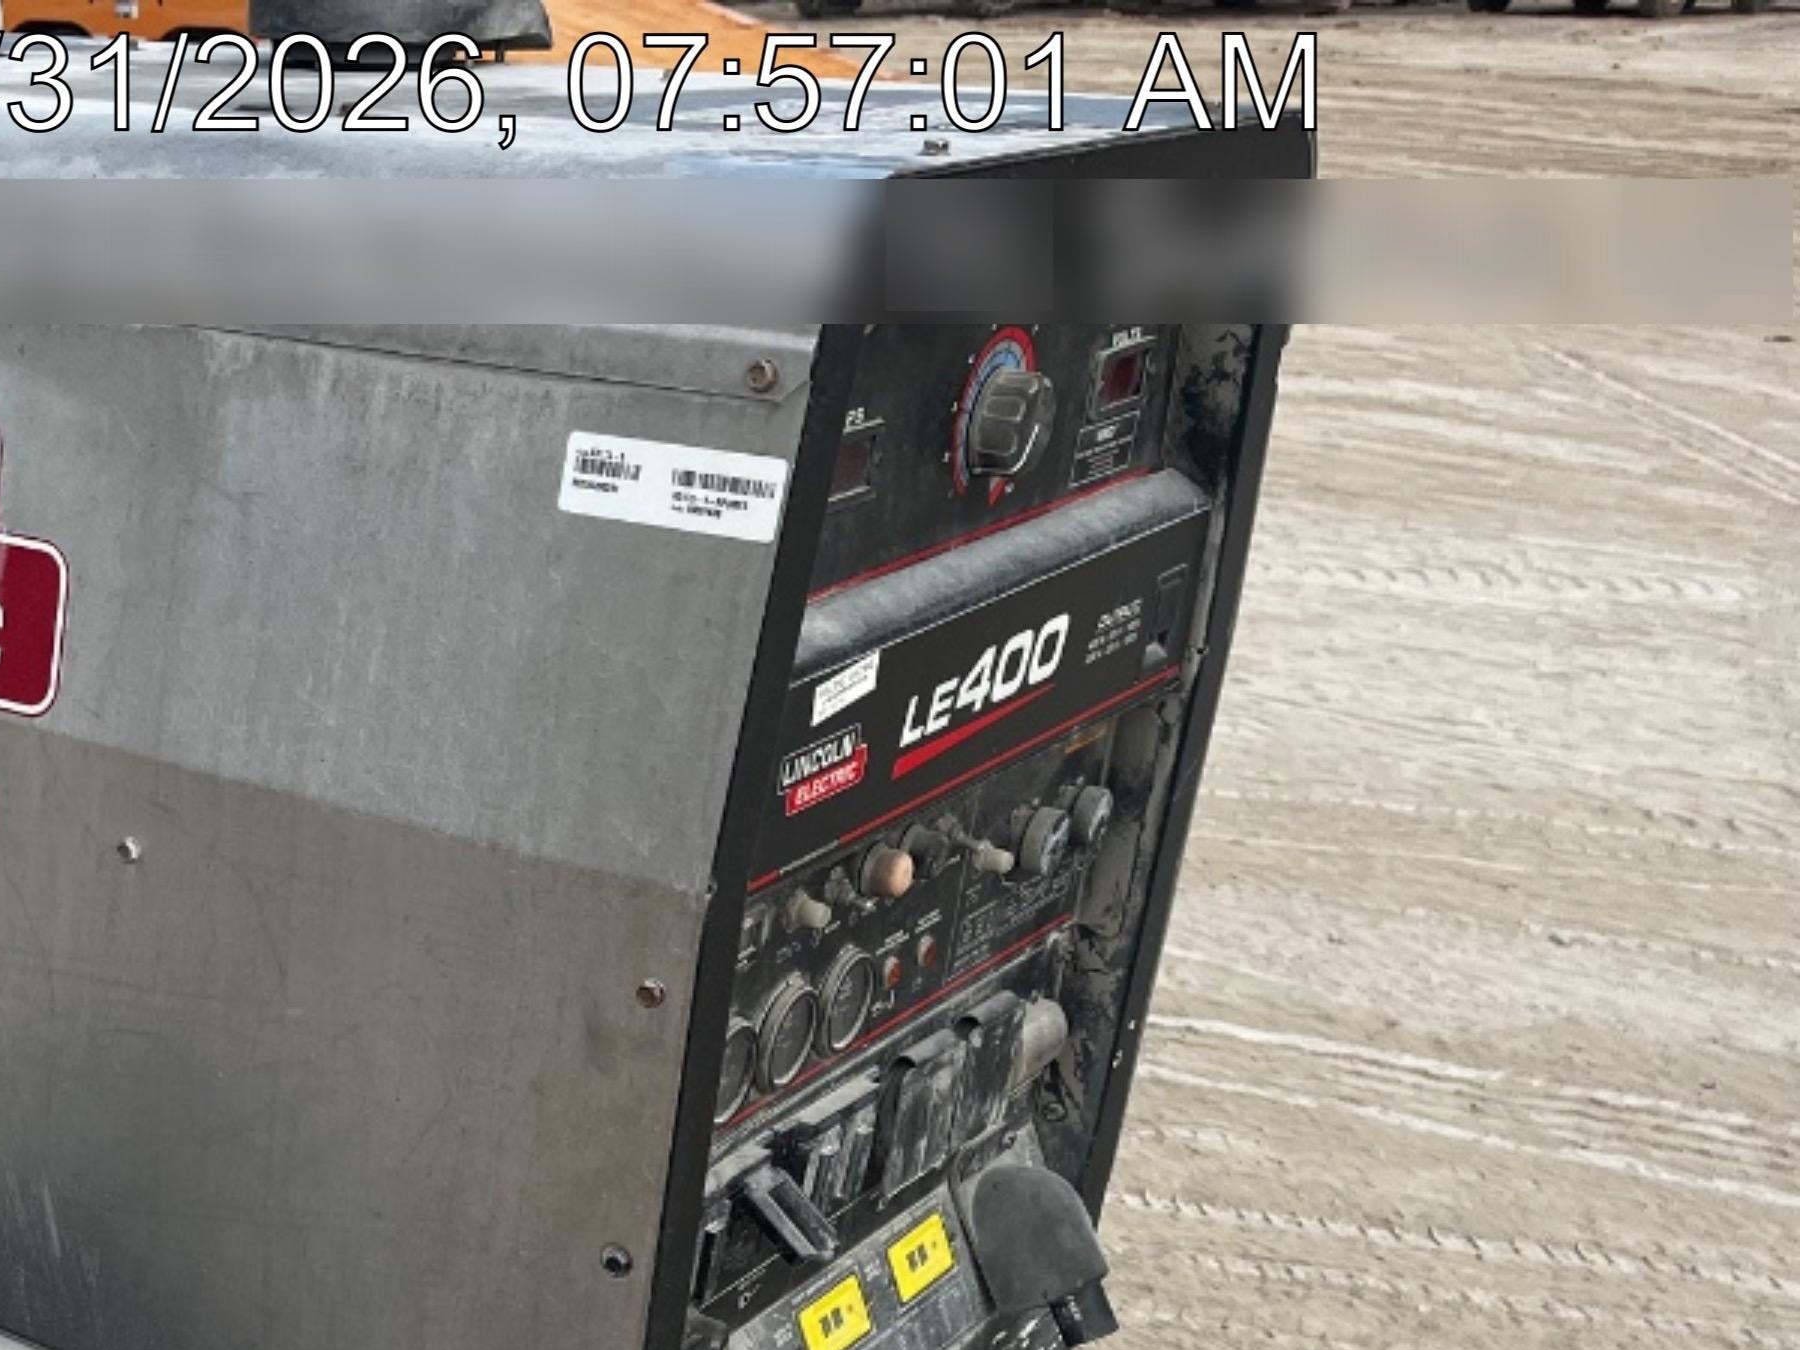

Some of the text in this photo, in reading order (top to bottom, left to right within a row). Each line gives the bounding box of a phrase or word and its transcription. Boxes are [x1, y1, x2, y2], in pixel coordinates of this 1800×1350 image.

[900, 611, 1071, 749] LE400
[782, 730, 856, 788] LINCOLN
[794, 760, 859, 806] ELECTRIC
